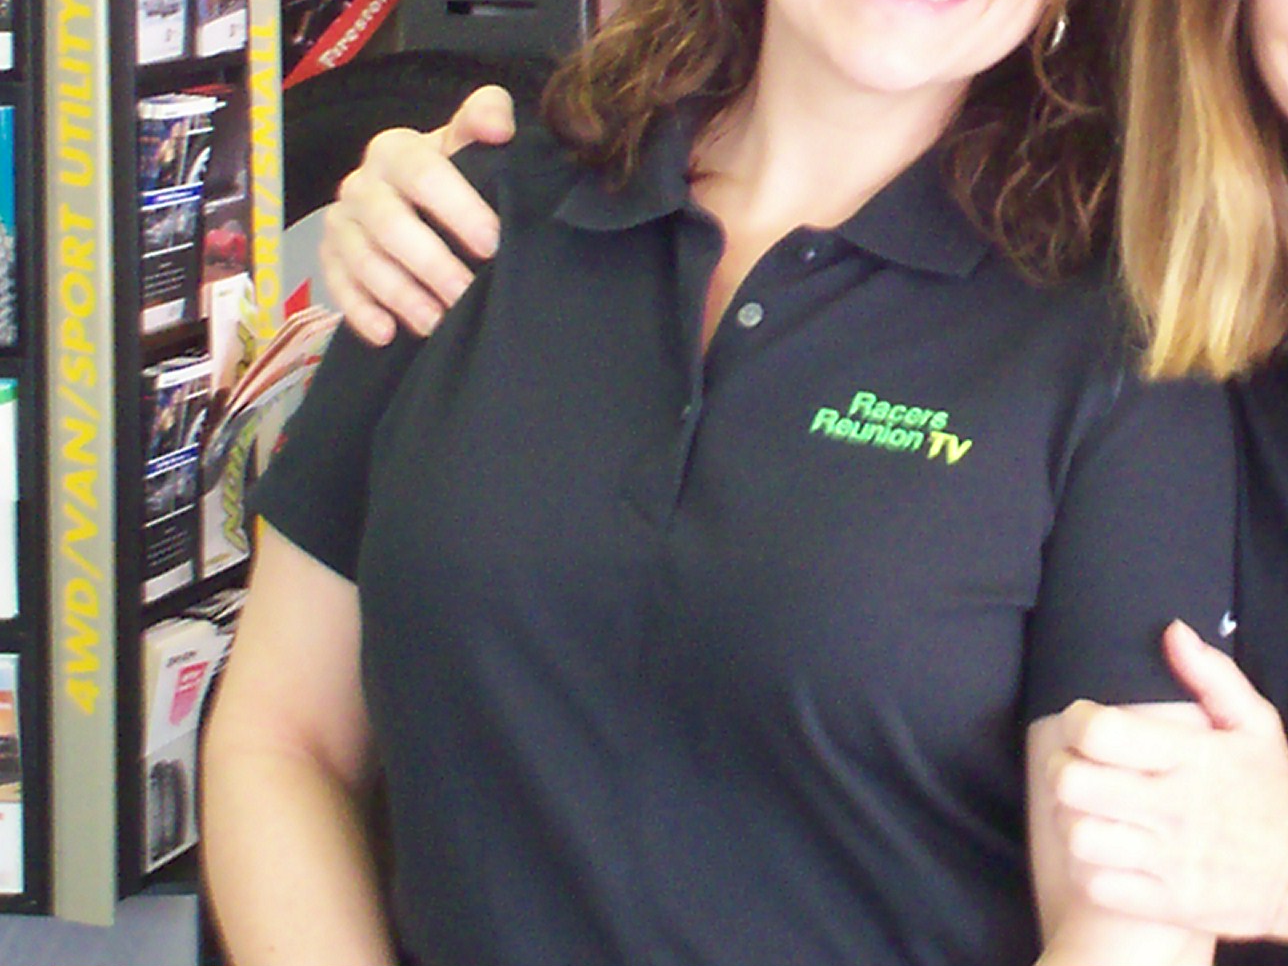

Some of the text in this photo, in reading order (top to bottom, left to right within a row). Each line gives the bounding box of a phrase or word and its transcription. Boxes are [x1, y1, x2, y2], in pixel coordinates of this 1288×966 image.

[250, 18, 281, 362] PORT/SMALL
[808, 406, 974, 466] Reunion TV
[847, 389, 950, 432] Racers
